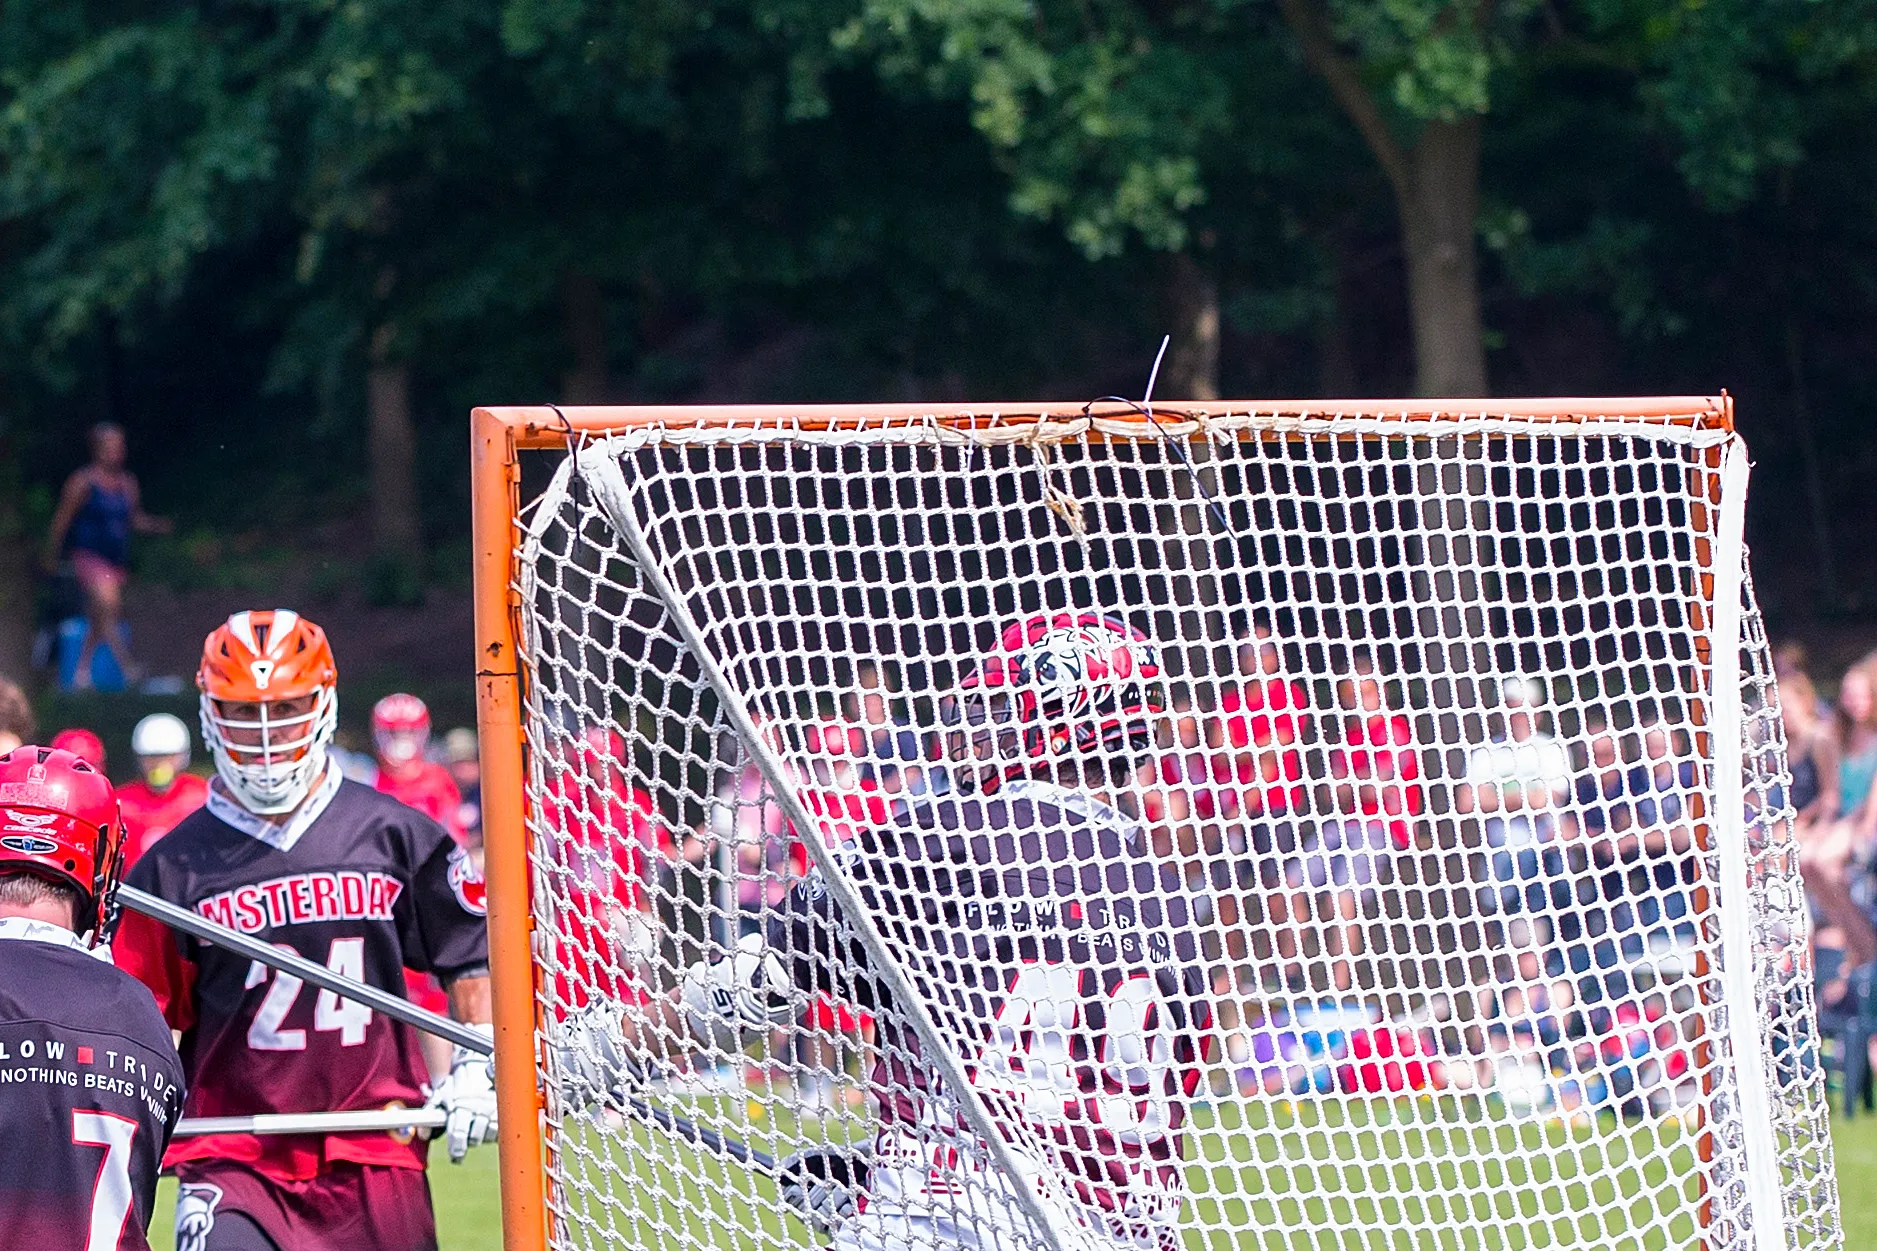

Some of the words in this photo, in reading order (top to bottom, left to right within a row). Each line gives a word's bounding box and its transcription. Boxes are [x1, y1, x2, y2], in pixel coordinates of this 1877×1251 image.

[192, 871, 405, 942] MSTERDA
[245, 937, 373, 1051] 24
[1, 1067, 78, 1087] NOTHING
[84, 1073, 135, 1097] BEATS
